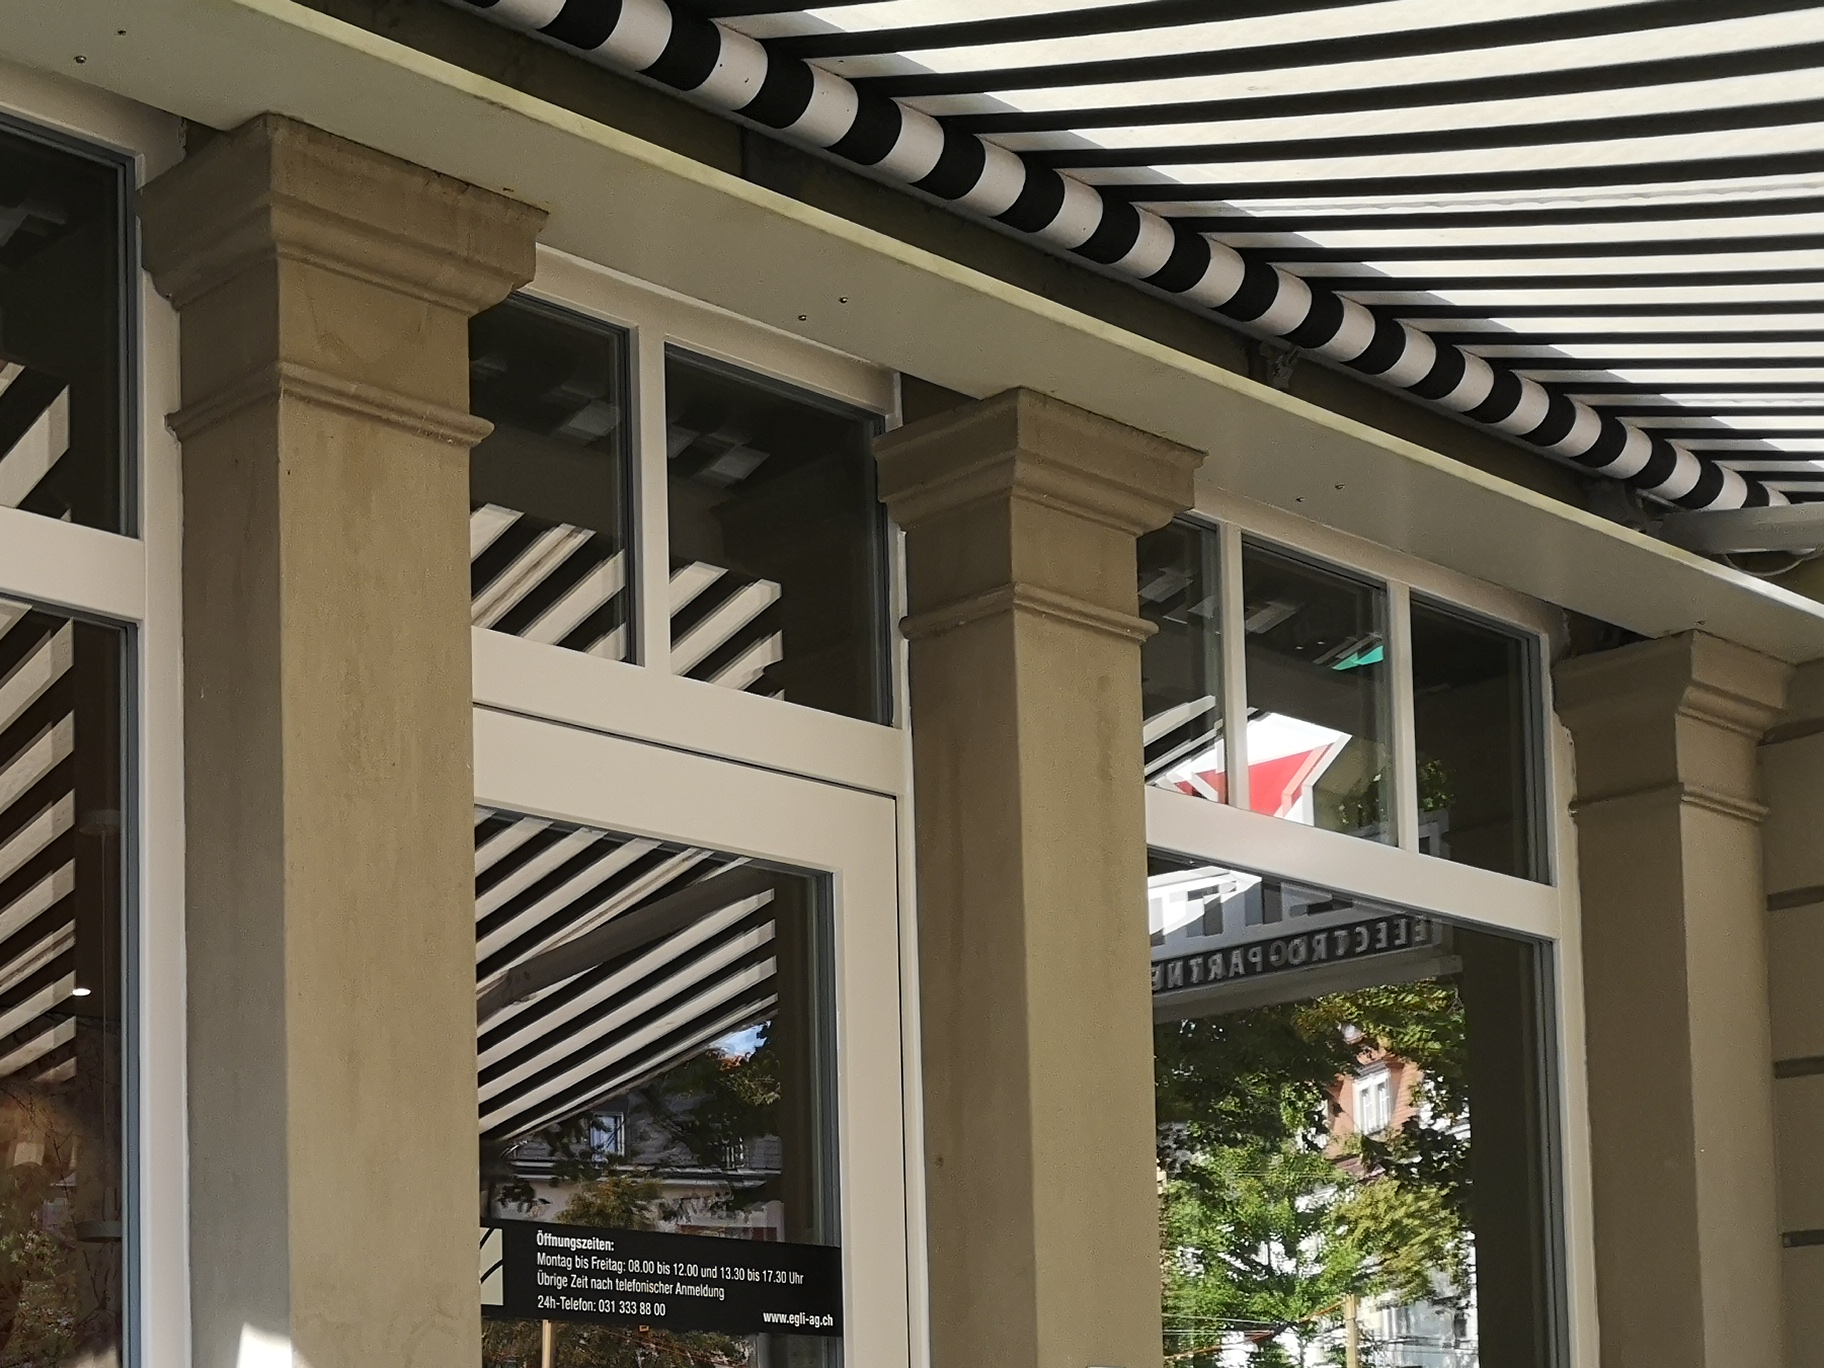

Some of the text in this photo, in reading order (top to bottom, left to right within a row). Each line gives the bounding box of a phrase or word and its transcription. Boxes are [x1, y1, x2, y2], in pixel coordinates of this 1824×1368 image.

[537, 1230, 614, 1251] Öffnungszeiten:
[537, 1252, 804, 1284] Montag bis Freitag: 08.00 bis 12.00 und 13.30 bis 17.30 Uhr
[537, 1269, 725, 1300] Übrige Zeit nach telefonischer Anmeldung
[537, 1295, 666, 1317] 24h-Telefon: 031 333 88 00
[762, 1311, 834, 1328] www.egli-ag.ch
